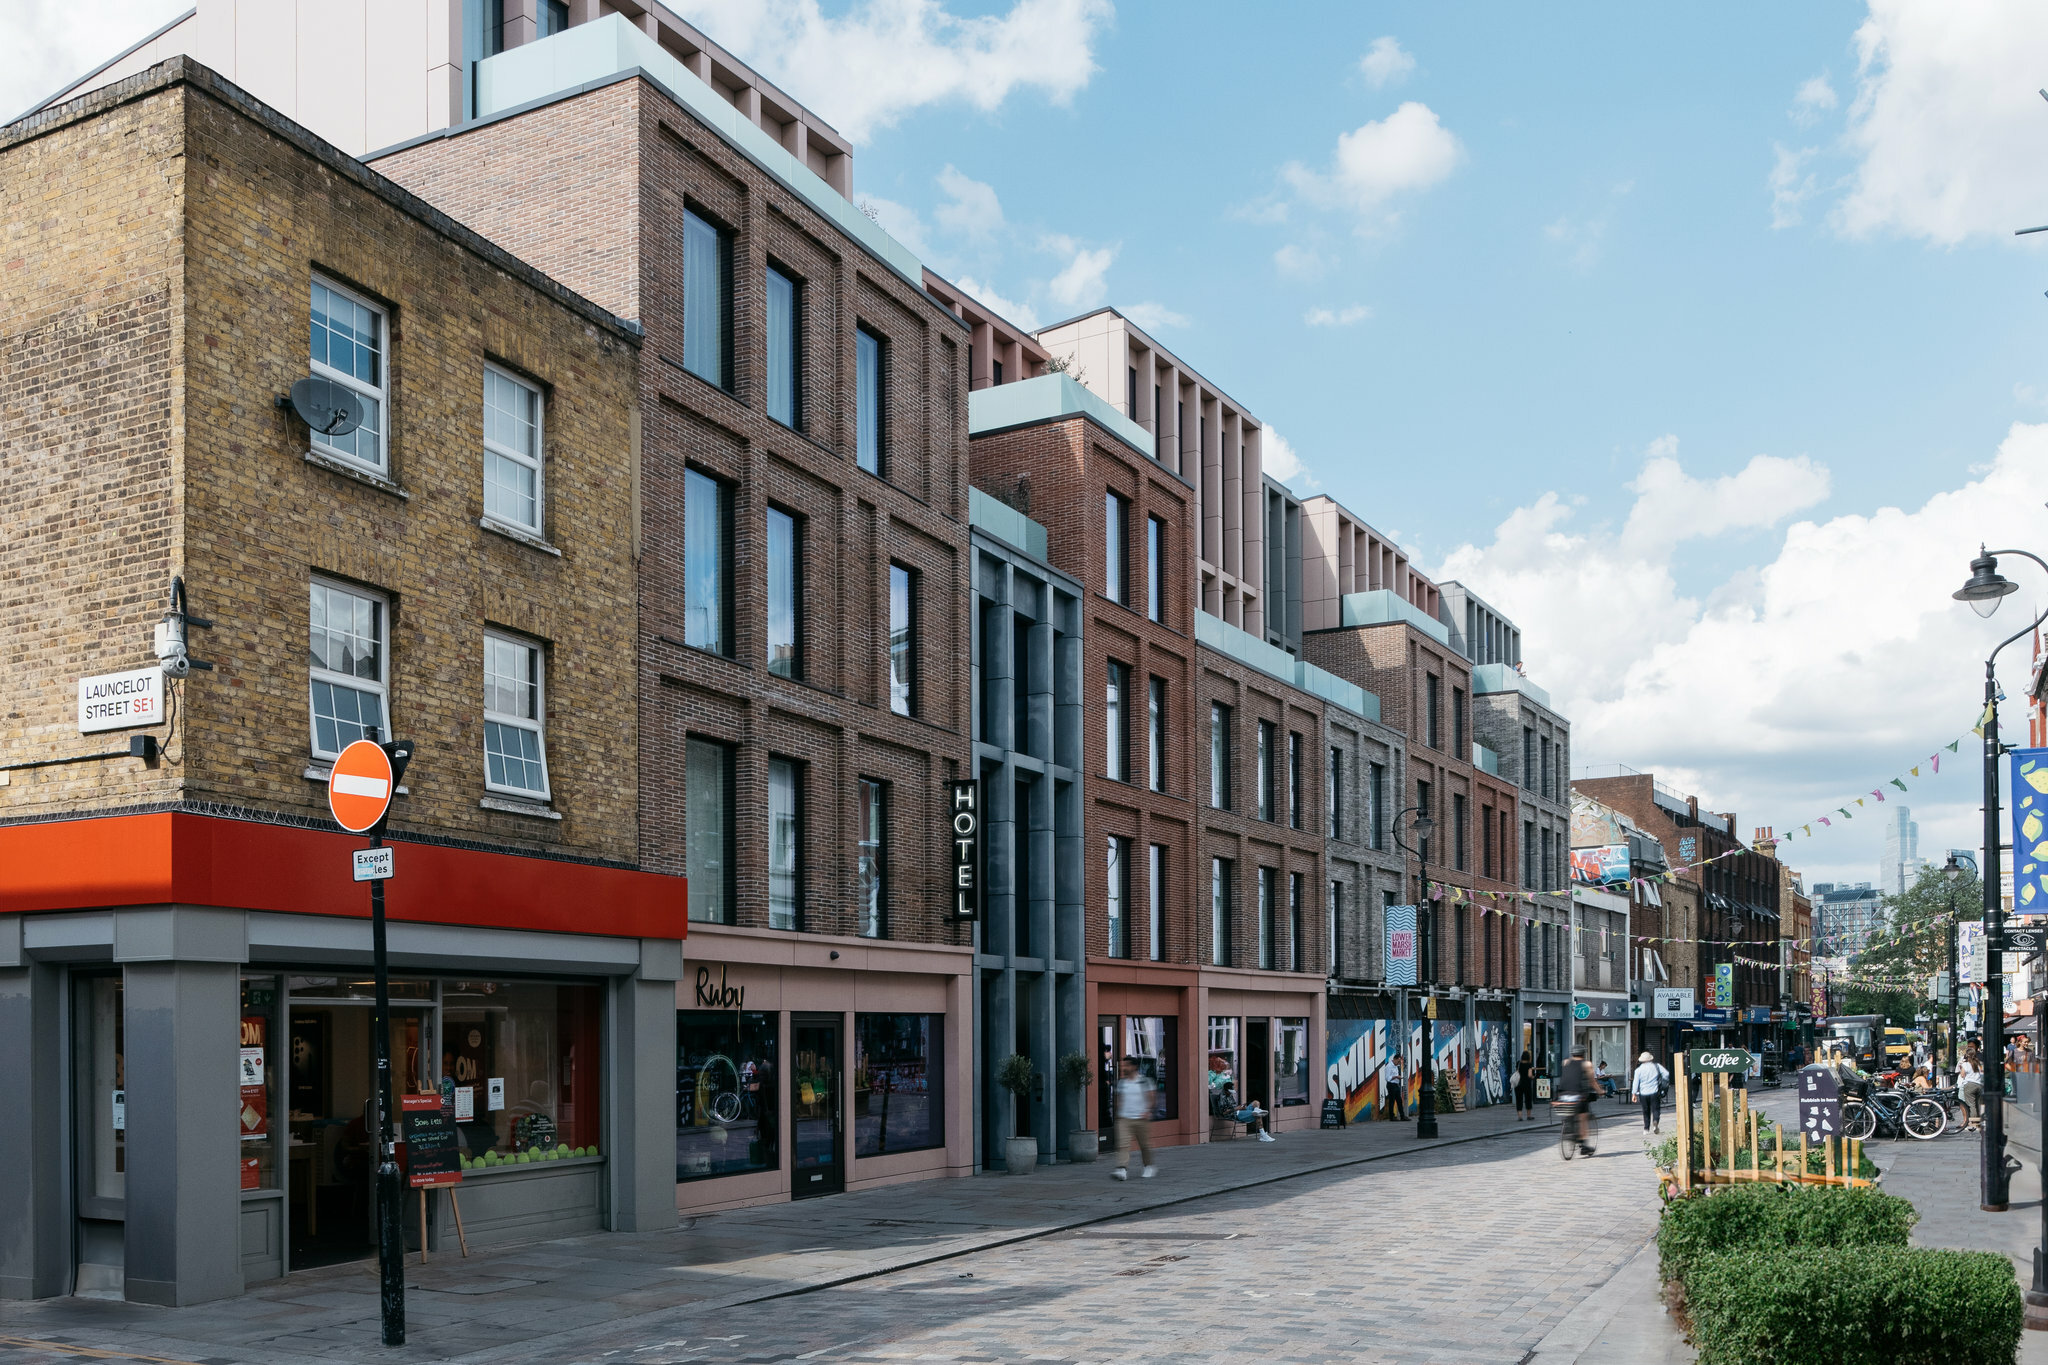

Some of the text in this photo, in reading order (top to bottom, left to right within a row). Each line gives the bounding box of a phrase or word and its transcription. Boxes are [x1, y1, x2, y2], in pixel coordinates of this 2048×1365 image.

[86, 677, 152, 699] LAUNCELOT
[86, 697, 154, 719] STREET SE1
[357, 852, 389, 863] Except
[954, 785, 976, 915] HOTEL
[1391, 933, 1412, 941] LOWER
[1391, 940, 1412, 949] MARSH
[1391, 948, 1412, 958] MARKET
[696, 963, 745, 1043] Ruby
[1575, 1007, 1587, 1018] 74
[1328, 1019, 1386, 1101] SMILE
[1700, 1053, 1739, 1069] Coffee
